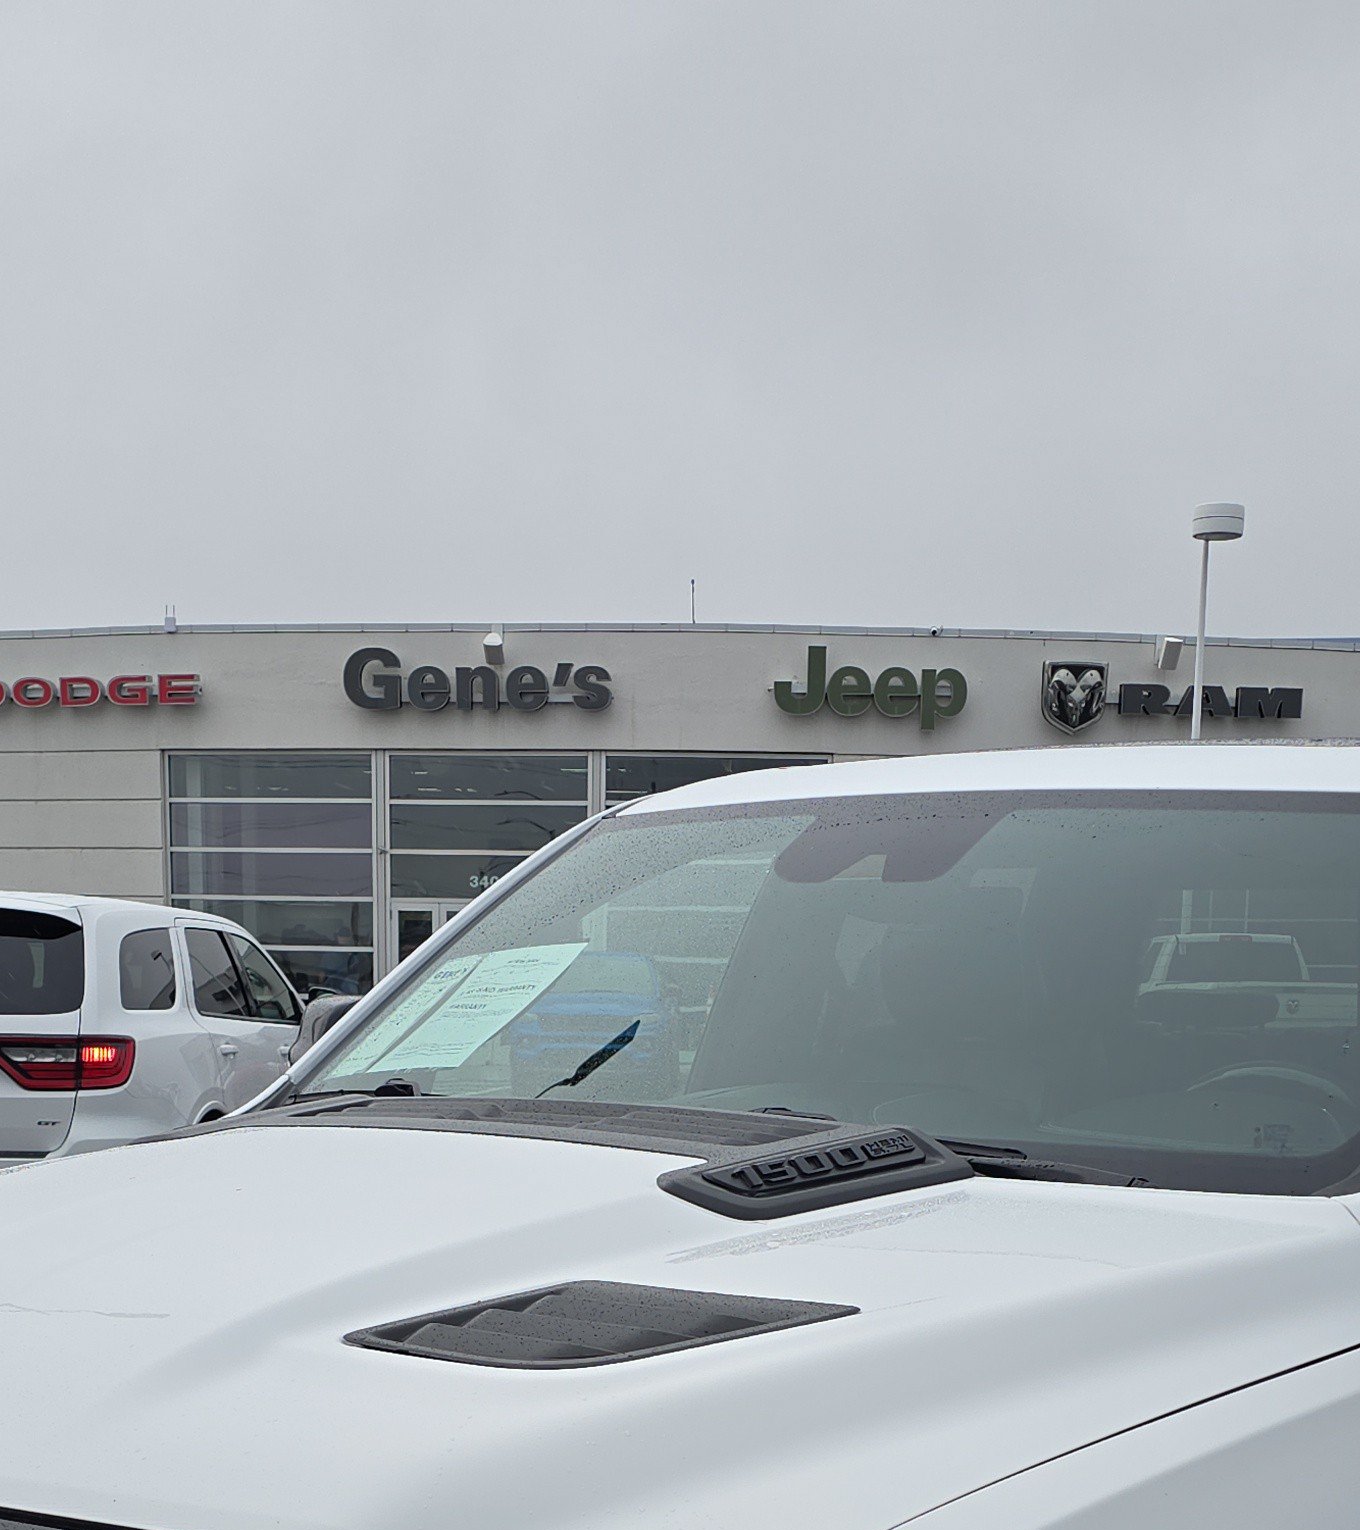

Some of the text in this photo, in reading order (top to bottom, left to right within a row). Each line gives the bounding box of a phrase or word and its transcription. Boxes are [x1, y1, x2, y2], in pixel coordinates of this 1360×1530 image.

[343, 647, 614, 712] Gene's
[774, 645, 968, 731] Jeep
[1118, 684, 1304, 719] RAM
[731, 1147, 868, 1188] 1500
